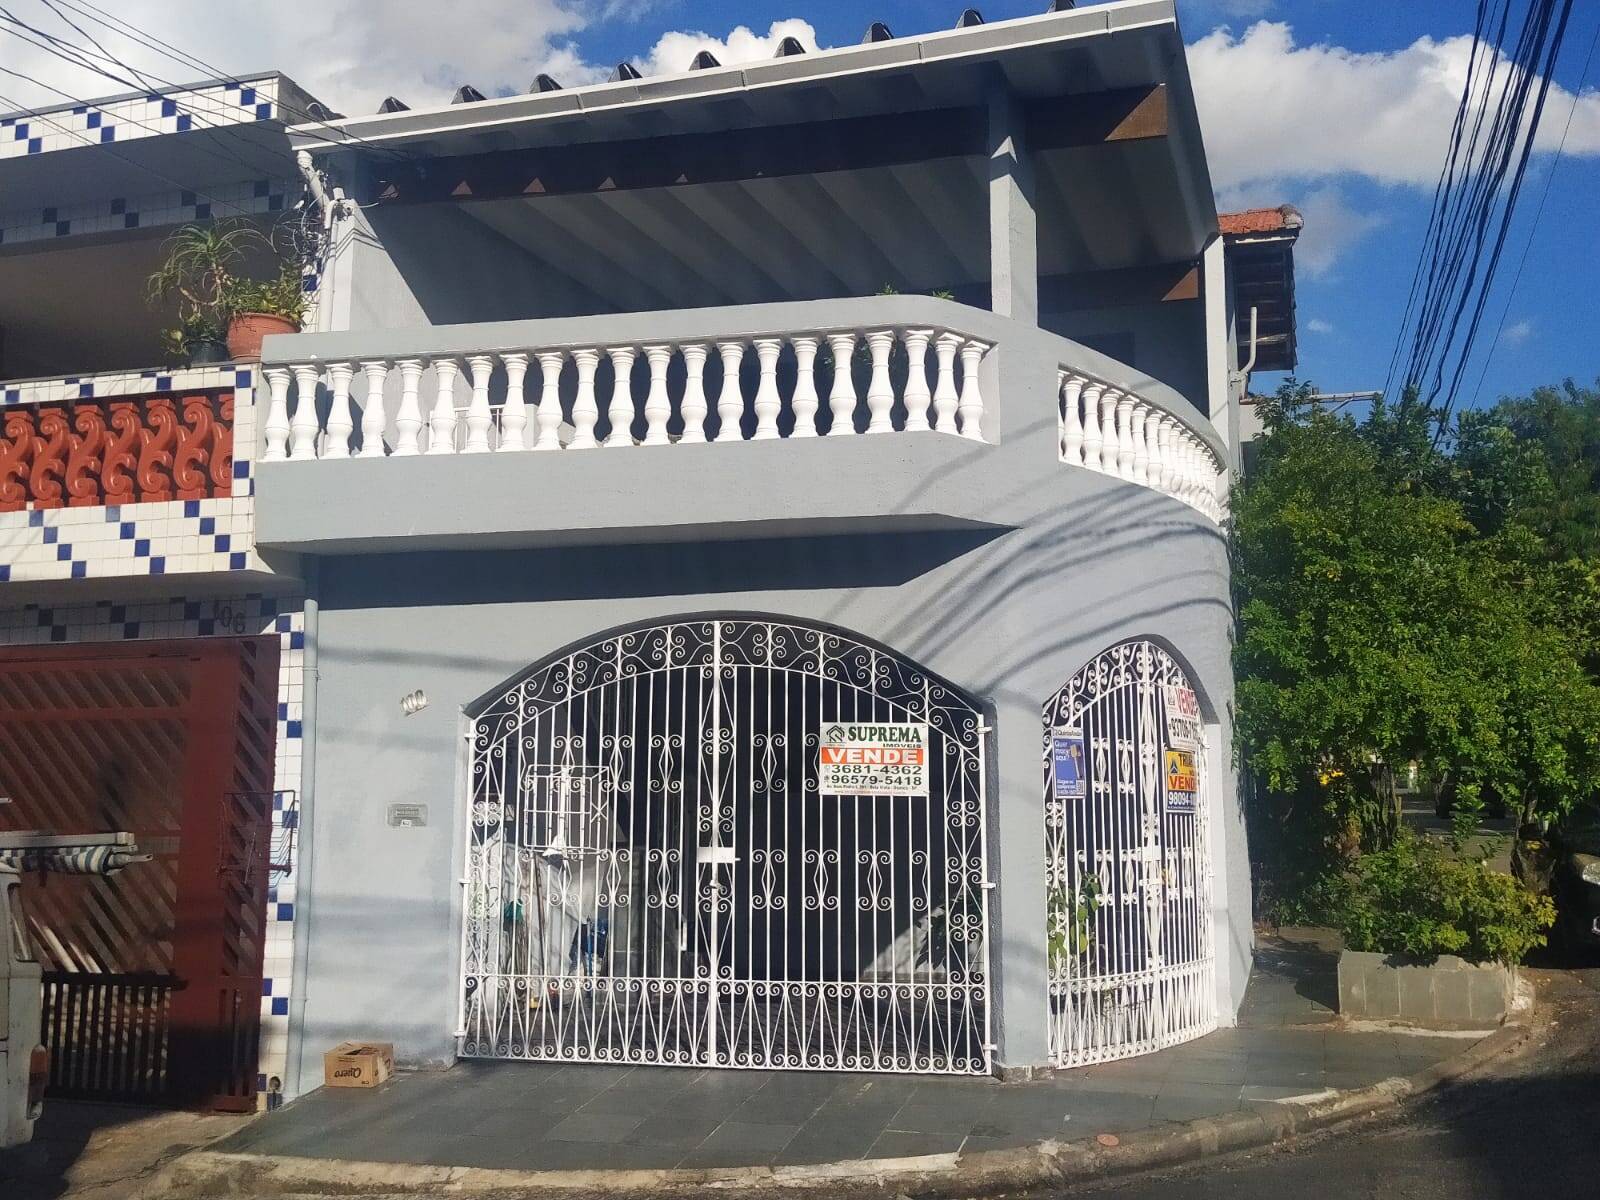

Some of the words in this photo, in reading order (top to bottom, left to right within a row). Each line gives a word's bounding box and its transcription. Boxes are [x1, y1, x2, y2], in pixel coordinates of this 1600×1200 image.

[847, 726, 922, 742] SUPREMA
[826, 748, 919, 764] VENDE
[831, 765, 922, 775] 3681-4362
[831, 774, 922, 786] 96579-5418
[1169, 776, 1195, 790] VEND
[334, 1067, 362, 1079] Quero
